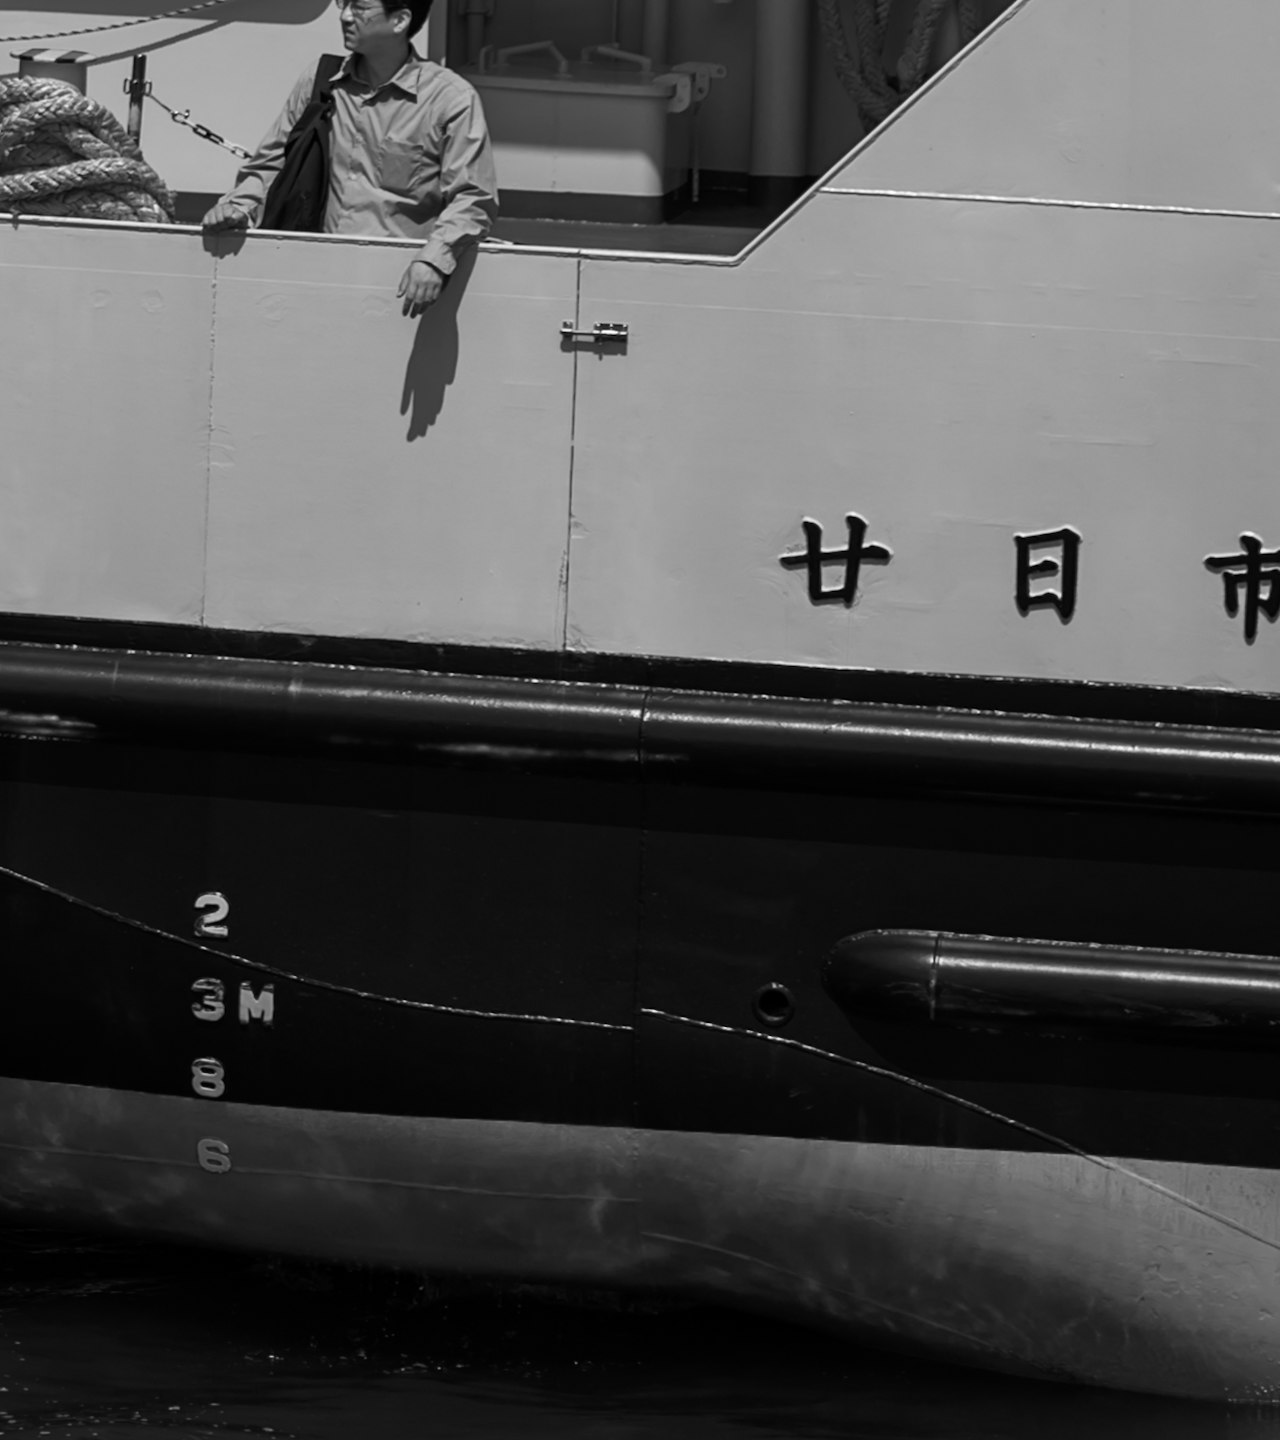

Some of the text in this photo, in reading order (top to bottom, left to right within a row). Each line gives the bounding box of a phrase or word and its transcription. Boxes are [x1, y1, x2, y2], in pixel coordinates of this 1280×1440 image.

[193, 891, 230, 938] 2
[191, 1057, 226, 1098] 8
[197, 1138, 231, 1173] 6
